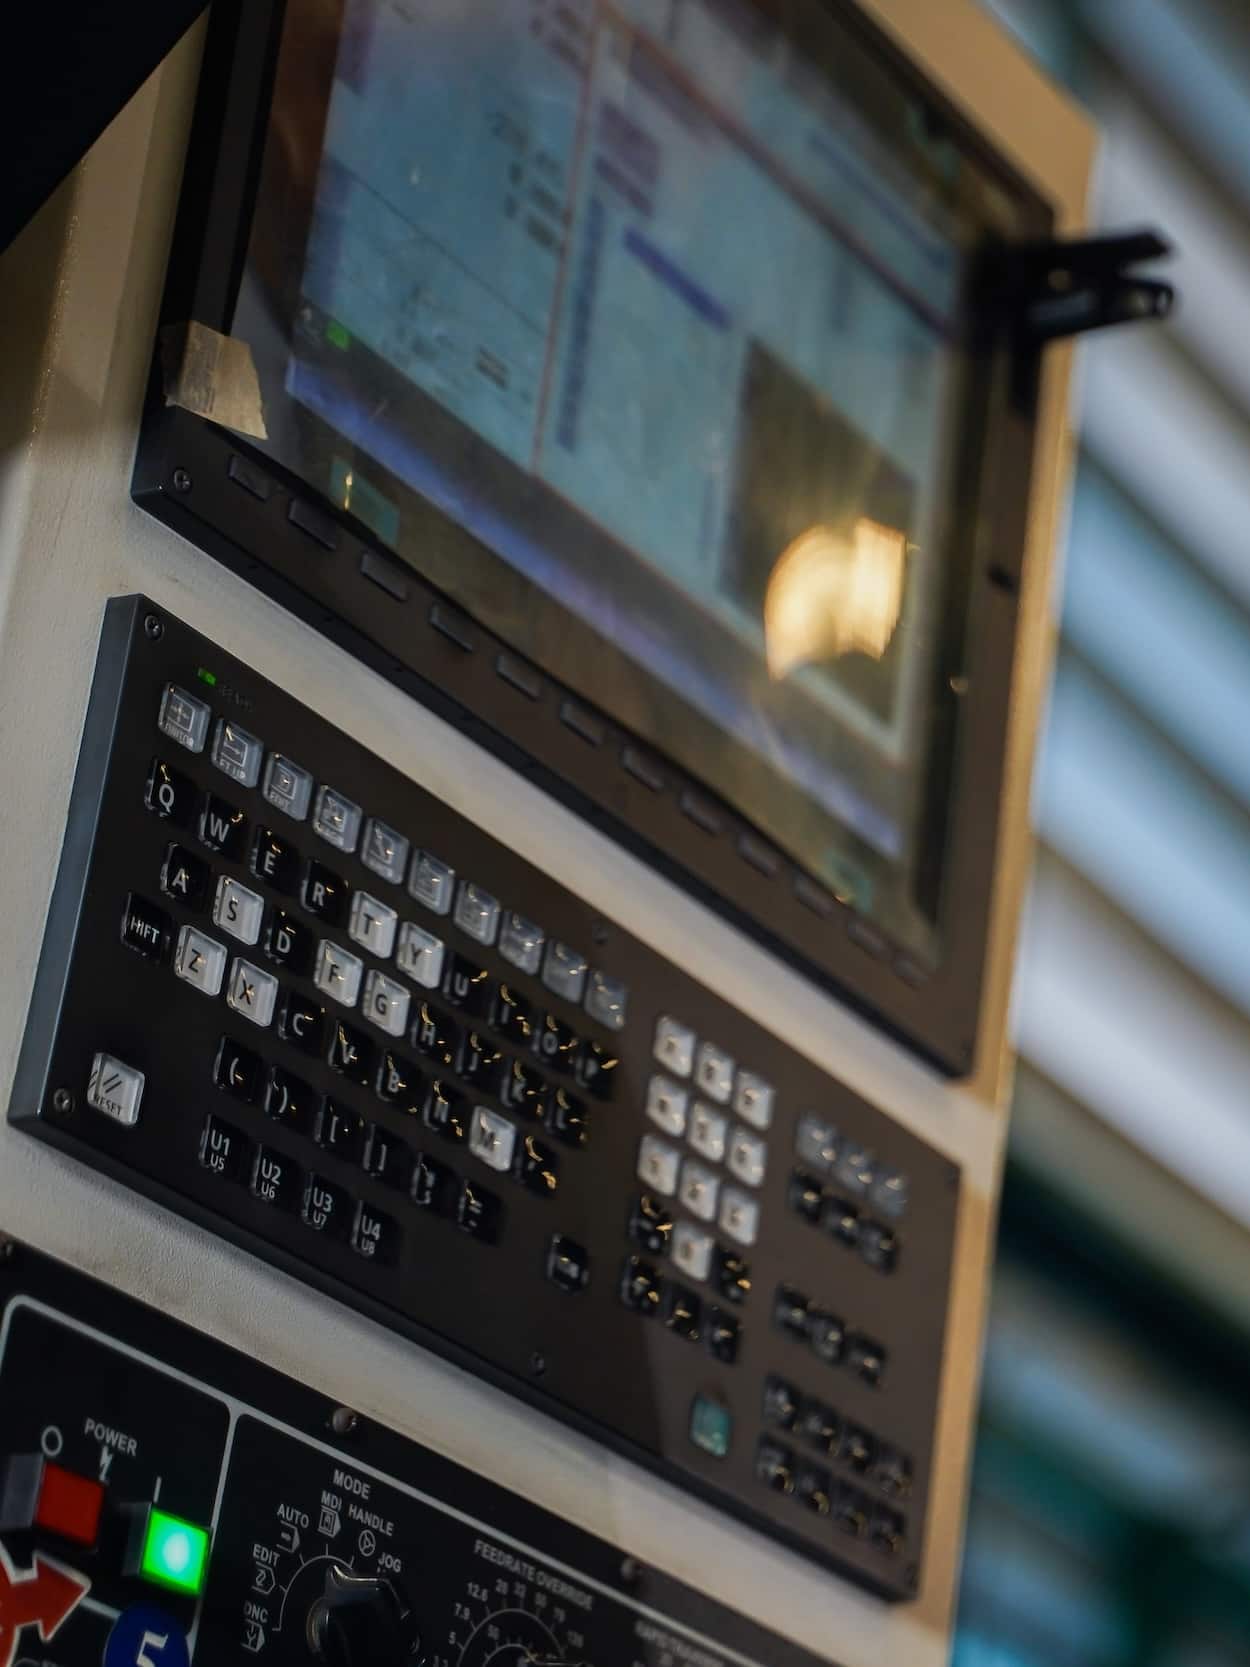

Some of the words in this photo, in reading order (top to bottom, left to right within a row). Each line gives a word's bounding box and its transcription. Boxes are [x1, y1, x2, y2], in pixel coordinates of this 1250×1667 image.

[158, 783, 175, 813] Q
[209, 812, 230, 843] W
[263, 851, 277, 874] E
[171, 867, 188, 894] A
[312, 881, 325, 907] R
[226, 898, 239, 922] S
[128, 915, 160, 944] HIFT
[363, 912, 375, 935] T
[276, 929, 291, 954] D
[411, 943, 423, 965] Y
[187, 947, 202, 973] Z
[328, 963, 340, 983] F
[454, 972, 468, 997] U
[239, 978, 254, 1005] X
[375, 993, 387, 1015] G
[292, 1012, 305, 1037] C
[421, 1023, 436, 1046] H
[387, 1068, 400, 1093] B
[210, 1129, 231, 1157] U1
[209, 1153, 226, 1172] U5
[261, 1157, 282, 1186] U2
[261, 1180, 276, 1200] U6
[312, 1186, 333, 1213] U3
[312, 1210, 329, 1227] U7
[361, 1215, 382, 1241] U4
[361, 1238, 376, 1255] U8
[84, 1417, 138, 1457] POWER
[332, 1468, 371, 1500] MODE
[320, 1489, 343, 1511] MDI
[276, 1503, 310, 1529] AUTO
[348, 1502, 395, 1537] HANDLE
[252, 1543, 280, 1567] EDIT
[378, 1551, 402, 1573] JOG
[473, 1538, 536, 1583] FEEDRATE
[243, 1601, 269, 1624] DNC
